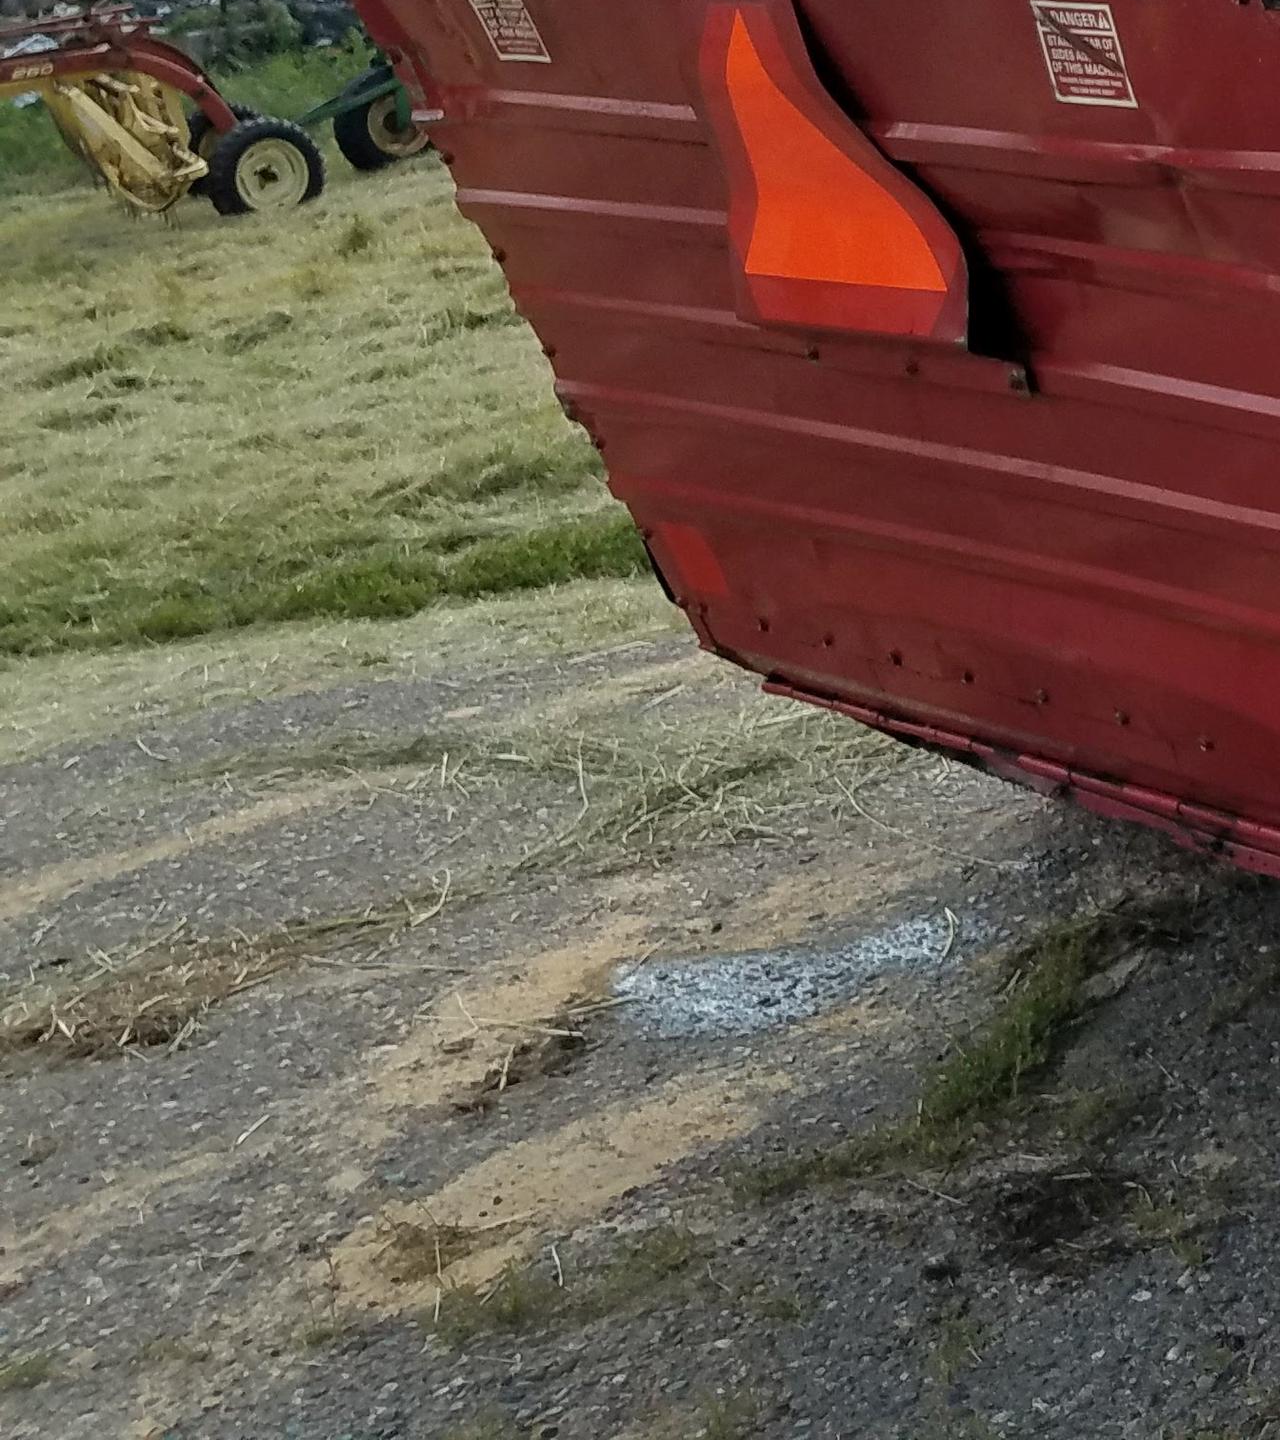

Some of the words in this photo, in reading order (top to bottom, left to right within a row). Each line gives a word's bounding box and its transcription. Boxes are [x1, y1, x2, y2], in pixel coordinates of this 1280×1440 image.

[1050, 10, 1097, 27] DANGER
[1052, 61, 1063, 73] OF
[1063, 62, 1083, 74] THIS
